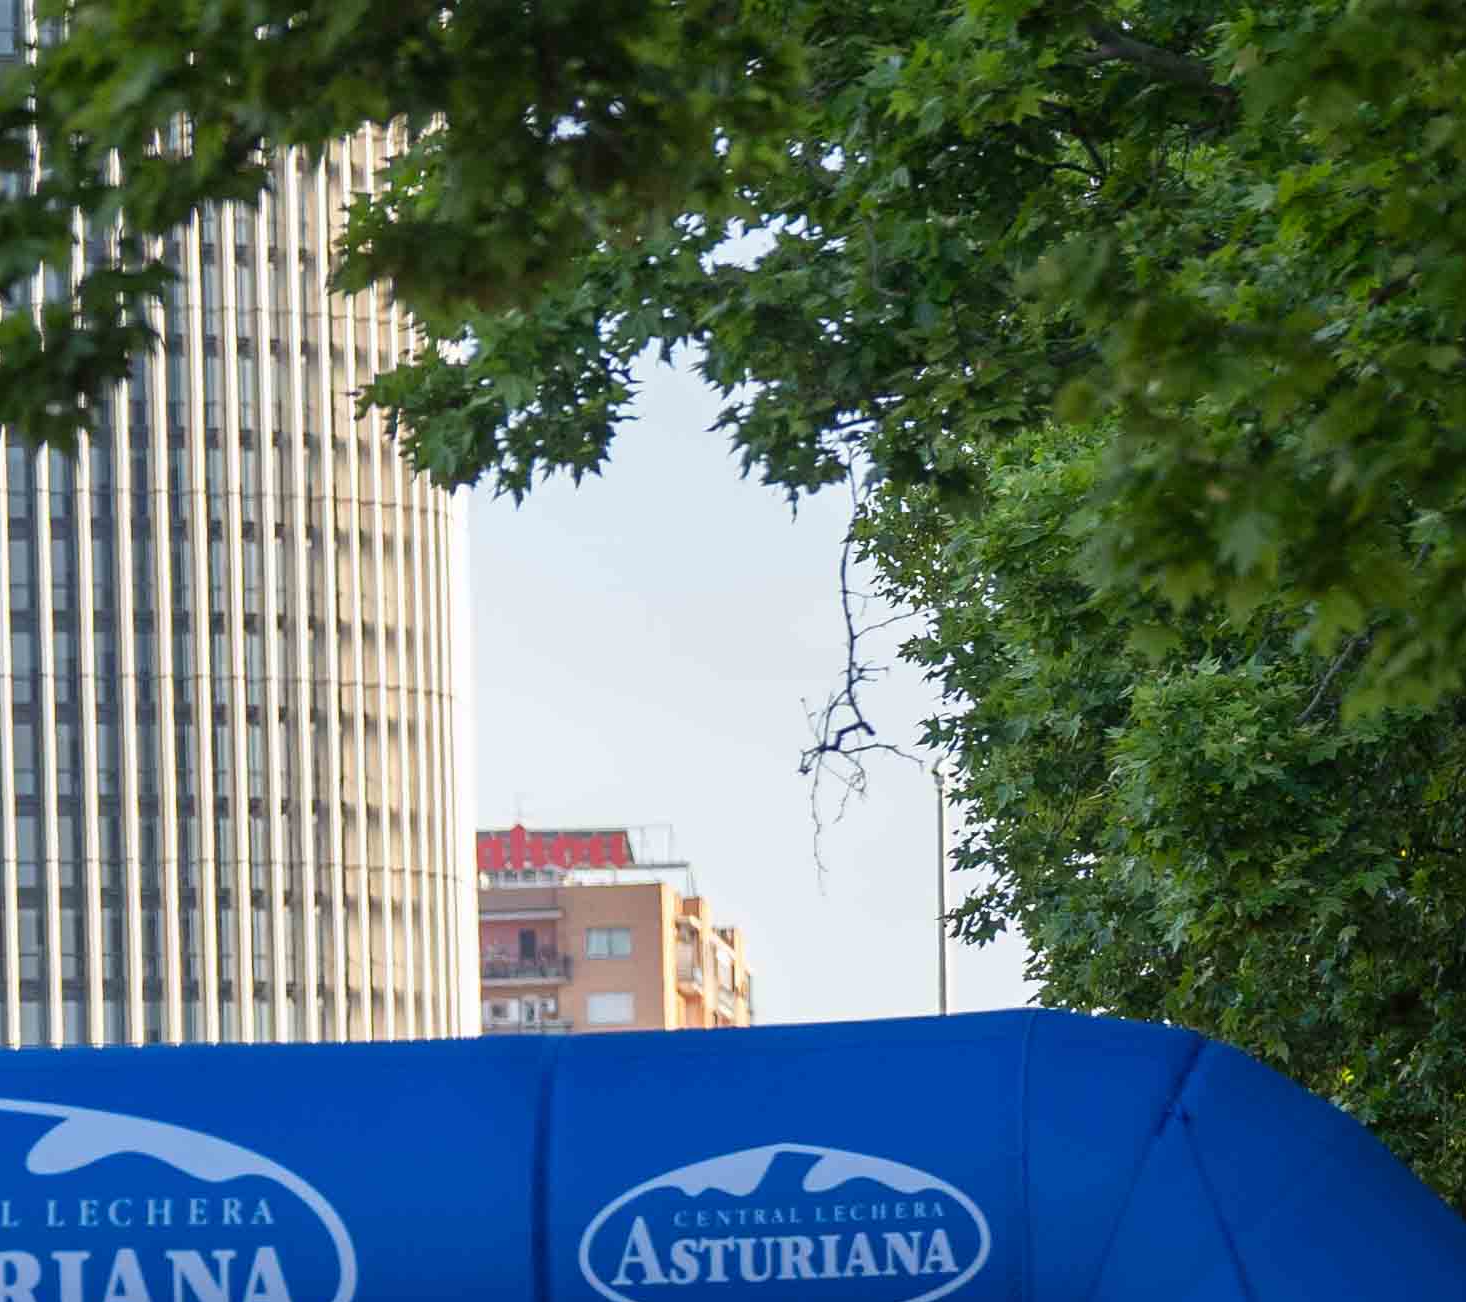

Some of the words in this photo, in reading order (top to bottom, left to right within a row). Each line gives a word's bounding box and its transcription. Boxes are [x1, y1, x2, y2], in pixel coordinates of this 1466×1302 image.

[46, 1196, 277, 1228] LECHERA
[674, 1207, 802, 1228] CENTRAL
[815, 1201, 946, 1222] LECHERA
[611, 1215, 960, 1286] ASTURIANA
